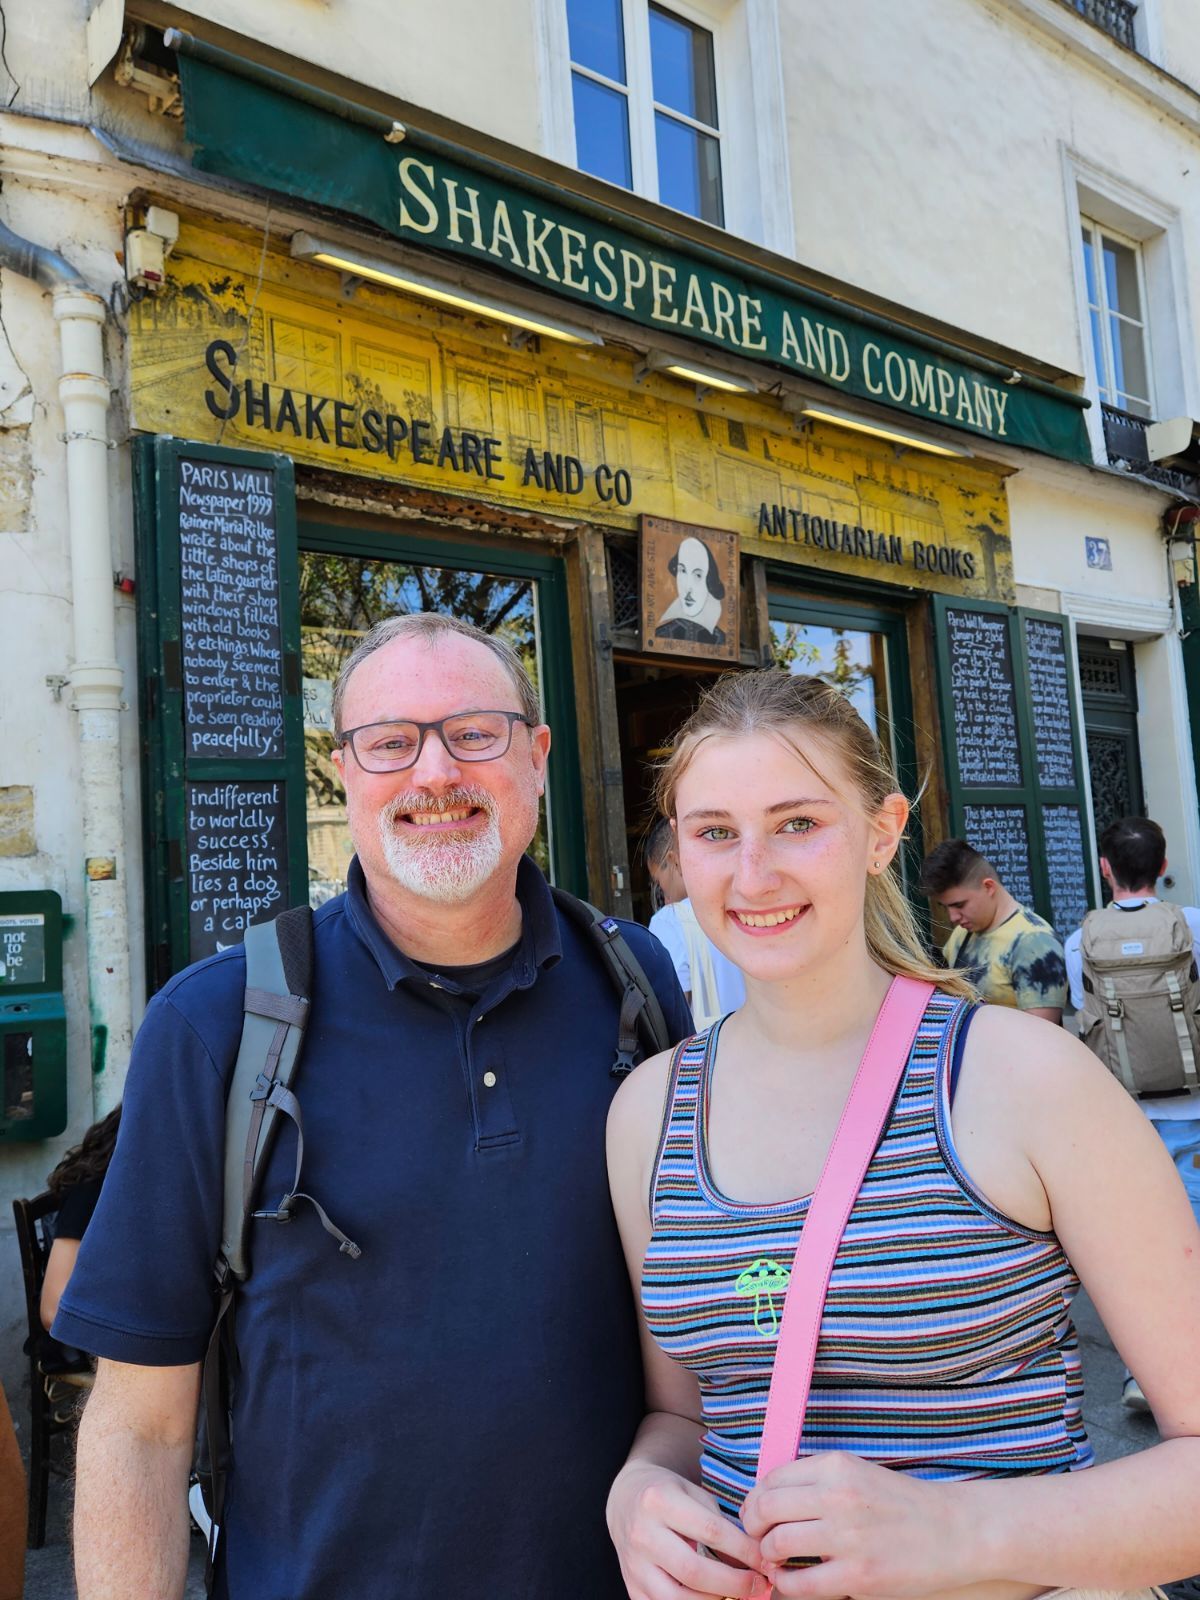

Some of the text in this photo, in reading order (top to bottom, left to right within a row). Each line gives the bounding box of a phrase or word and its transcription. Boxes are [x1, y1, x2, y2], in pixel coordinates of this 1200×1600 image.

[398, 157, 1009, 436] SHAKESPEARE AND COMPANY
[205, 340, 632, 506] SHAKESPEARE AND CO
[181, 462, 273, 496] PARIS WALL
[180, 486, 273, 516] Newspaper 1999
[180, 513, 275, 541] Rainer Maria Rilke
[180, 532, 276, 559] wrote about the
[758, 502, 903, 566] ANTIQUARIAN
[913, 540, 976, 580] BOOKS
[1089, 540, 1108, 567] 37
[182, 565, 204, 580] the
[234, 574, 278, 593] quarter
[221, 554, 258, 575] shops
[261, 560, 276, 579] of
[182, 582, 278, 613] with their shop
[182, 601, 278, 627] windows filled
[183, 617, 270, 640] with old books
[185, 634, 195, 650] &
[184, 652, 280, 676] nobody seemed
[186, 671, 280, 693] to enter & the
[187, 691, 282, 711] proprietor could
[188, 708, 283, 737] be seen reading
[192, 726, 278, 757] peacefully,
[191, 784, 279, 810] indifferent
[190, 809, 275, 834] to worldly
[190, 850, 278, 873] Beside him
[192, 872, 281, 901] lies a dog
[190, 892, 271, 915] or perhaps
[204, 911, 255, 931] a cat
[3, 932, 26, 943] not
[8, 944, 21, 954] to
[6, 954, 23, 967] be
